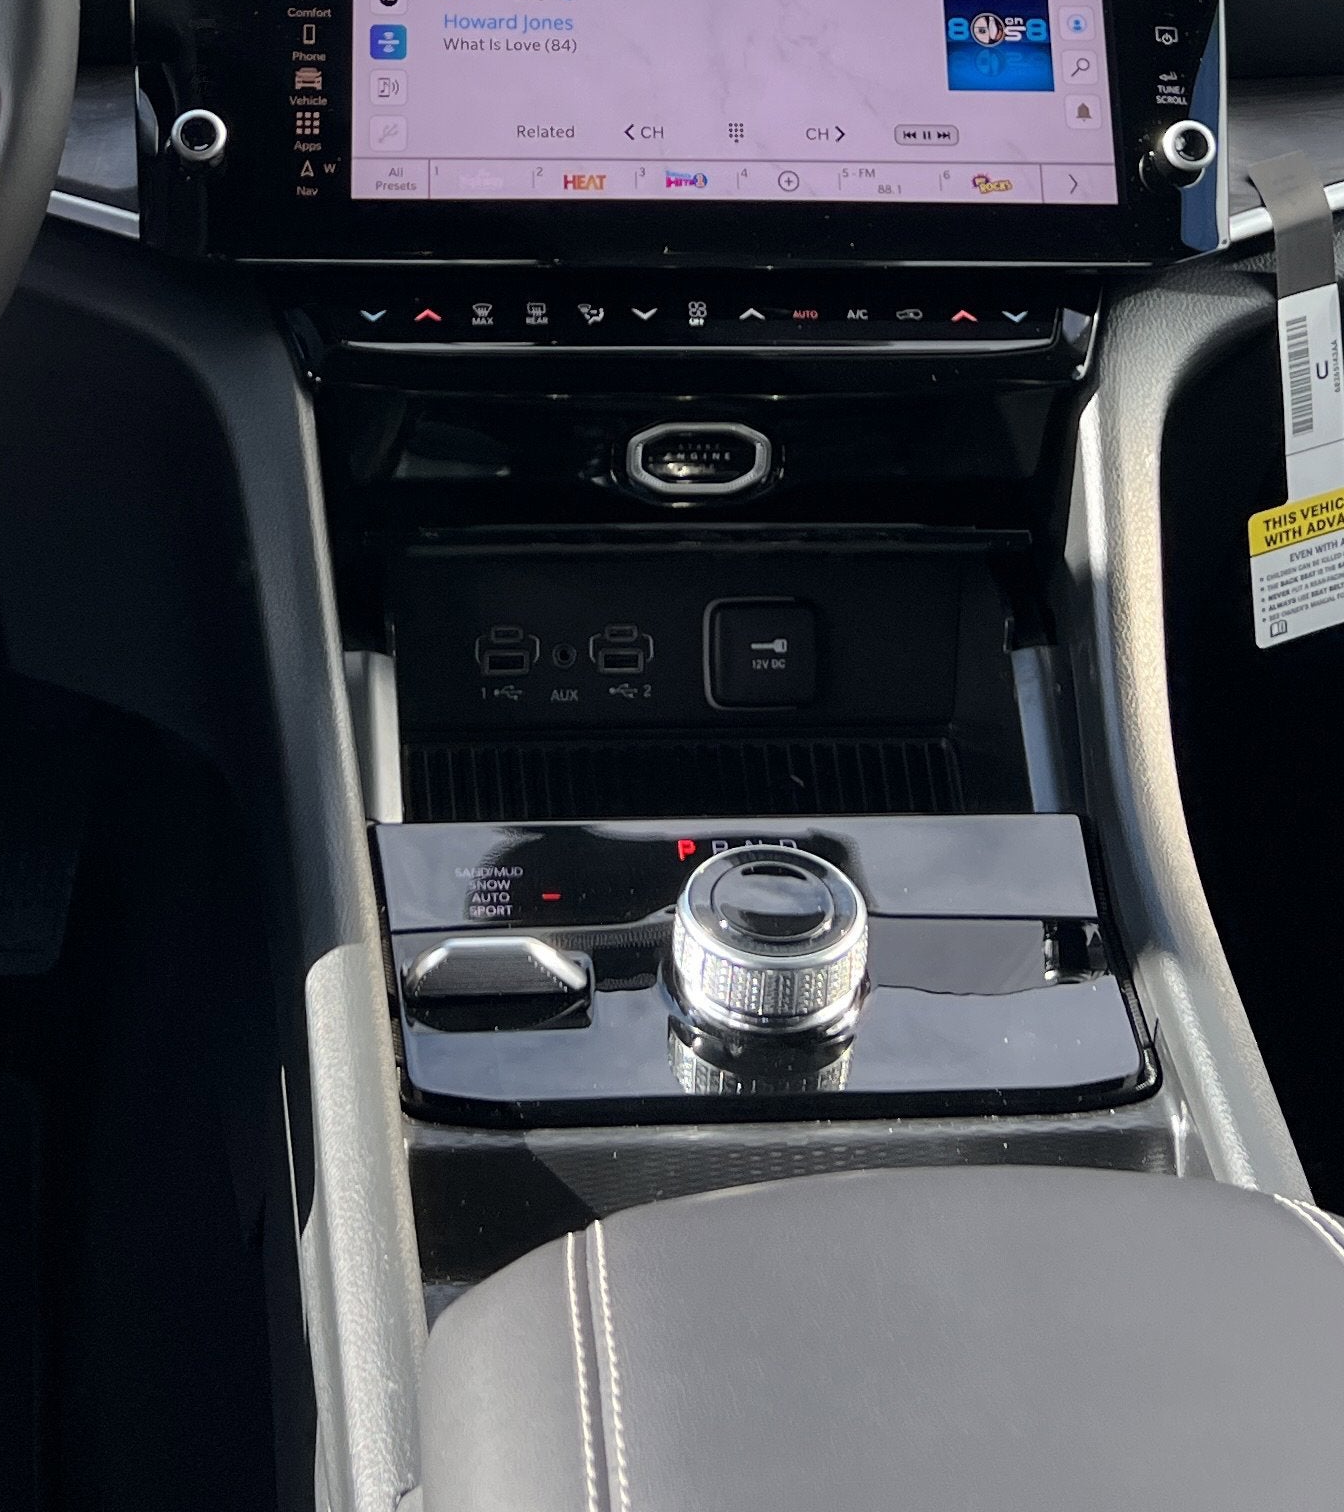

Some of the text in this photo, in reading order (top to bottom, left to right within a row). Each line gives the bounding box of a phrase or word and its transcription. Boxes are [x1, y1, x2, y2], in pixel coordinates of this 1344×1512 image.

[287, 7, 332, 19] Comfort
[443, 14, 574, 34] Howard Jones
[1025, 19, 1047, 42] 8
[443, 38, 577, 54] What Is Love (84)
[292, 50, 327, 62] Phone
[289, 95, 328, 107] Vehicle
[1155, 95, 1188, 106] SCROLL
[516, 125, 576, 139] Related
[640, 126, 665, 140] CH
[805, 128, 830, 141] CH
[293, 141, 323, 153] Apps
[388, 167, 404, 178] All
[536, 167, 544, 177] 2
[639, 167, 646, 177] 3
[740, 168, 748, 178] 4
[842, 168, 876, 178] 5 FM
[943, 170, 950, 180] 6
[375, 180, 417, 192] Presets
[563, 174, 607, 190] HEAT
[296, 186, 319, 197] Nav
[878, 184, 902, 195] 88.1
[792, 309, 819, 320] AUTO
[846, 309, 868, 320] A/C
[472, 317, 494, 326] MAX
[525, 317, 549, 325] REAR
[1316, 360, 1330, 380] U
[1263, 512, 1296, 532] THIS
[1264, 526, 1301, 548] WITH
[1290, 549, 1311, 563] EVEN
[1315, 541, 1337, 554] WITH
[751, 659, 786, 670] 12V DC
[550, 690, 579, 702] AUX
[643, 685, 652, 697] 2
[677, 839, 696, 862] P
[470, 879, 511, 891] SNOW
[471, 892, 511, 903] AUTO
[469, 905, 513, 917] SPORT
